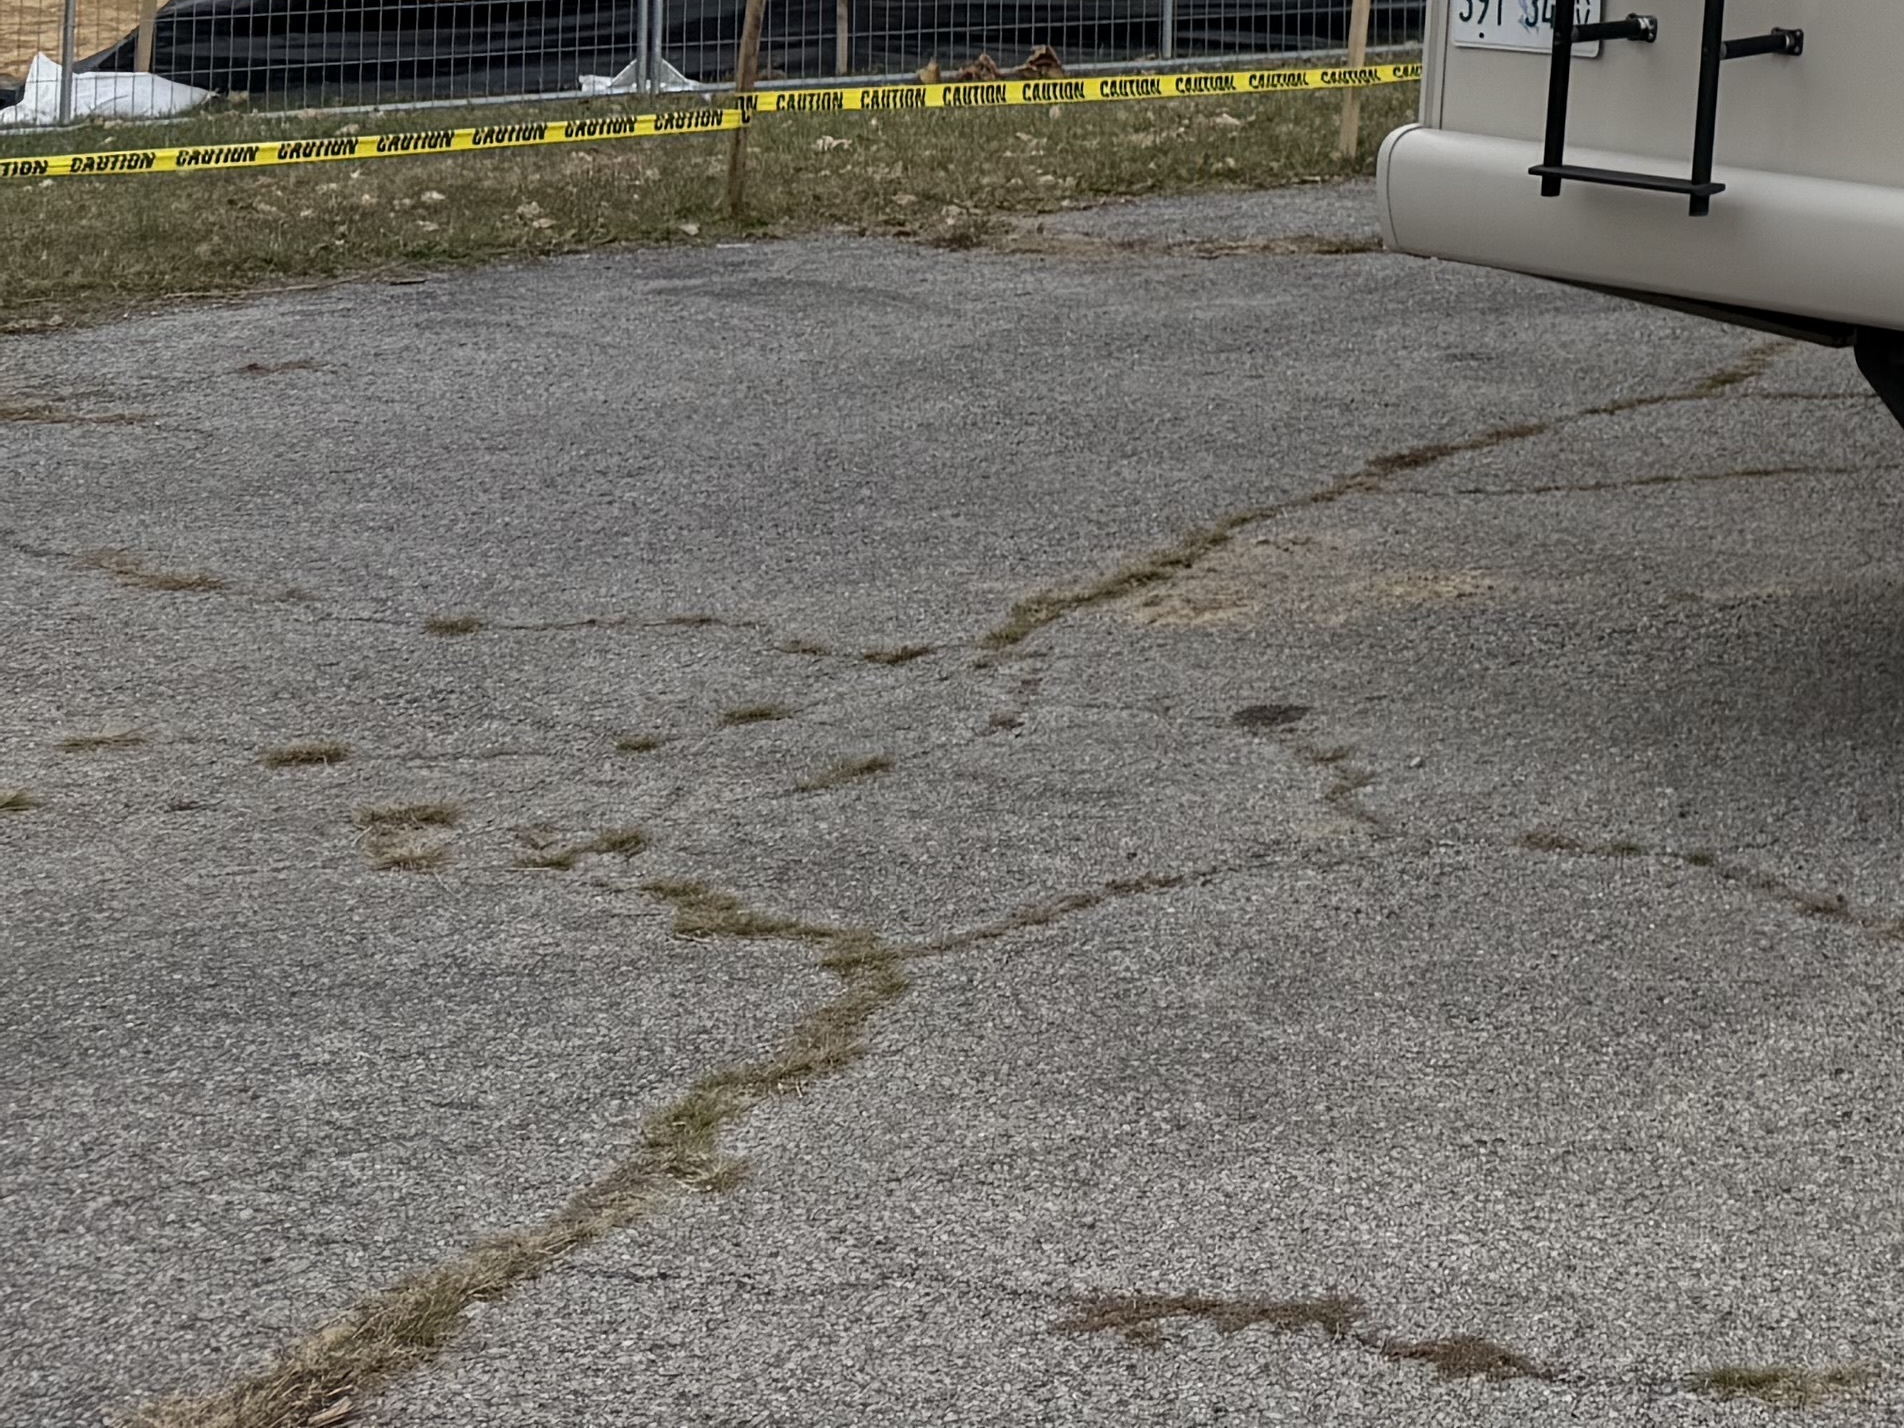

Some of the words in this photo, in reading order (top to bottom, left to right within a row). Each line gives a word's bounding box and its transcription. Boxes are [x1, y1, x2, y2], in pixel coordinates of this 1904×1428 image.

[0, 160, 48, 177] TION
[654, 110, 723, 131] CAUTION
[776, 91, 844, 111] CAUTION
[861, 88, 926, 109] CAUTION
[943, 84, 1006, 106] CAUTION
[1022, 81, 1085, 102] CAUTION
[1100, 77, 1162, 98] CAUTION
[1175, 75, 1237, 94] CAUTION
[1249, 72, 1309, 89] CAUTION
[1321, 68, 1382, 84] CAUTION
